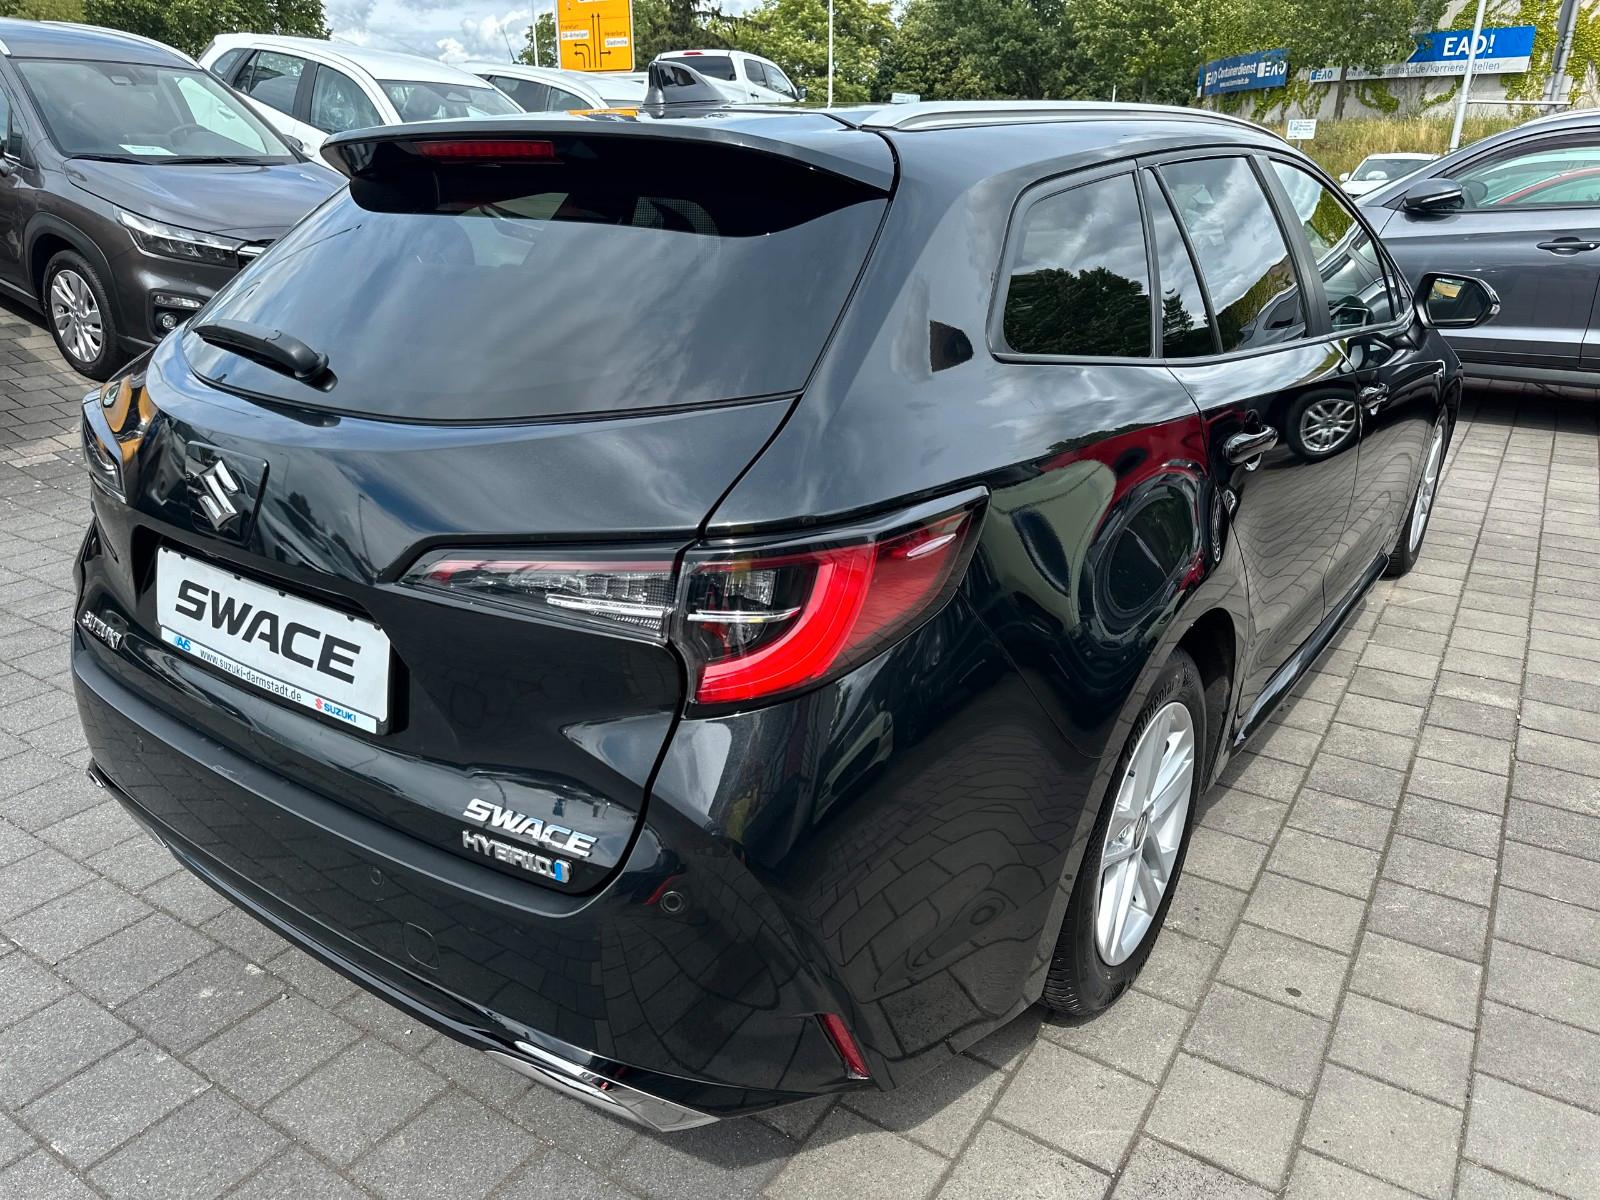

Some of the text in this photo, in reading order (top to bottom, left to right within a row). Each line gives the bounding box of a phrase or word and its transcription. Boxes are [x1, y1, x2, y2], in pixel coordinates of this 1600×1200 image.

[175, 579, 361, 684] SWACE
[200, 649, 302, 702] www.suzuki-darmstadt.de
[323, 703, 357, 723] SUZUKI
[462, 798, 598, 858] SWACE
[462, 830, 556, 878] HYBRID
